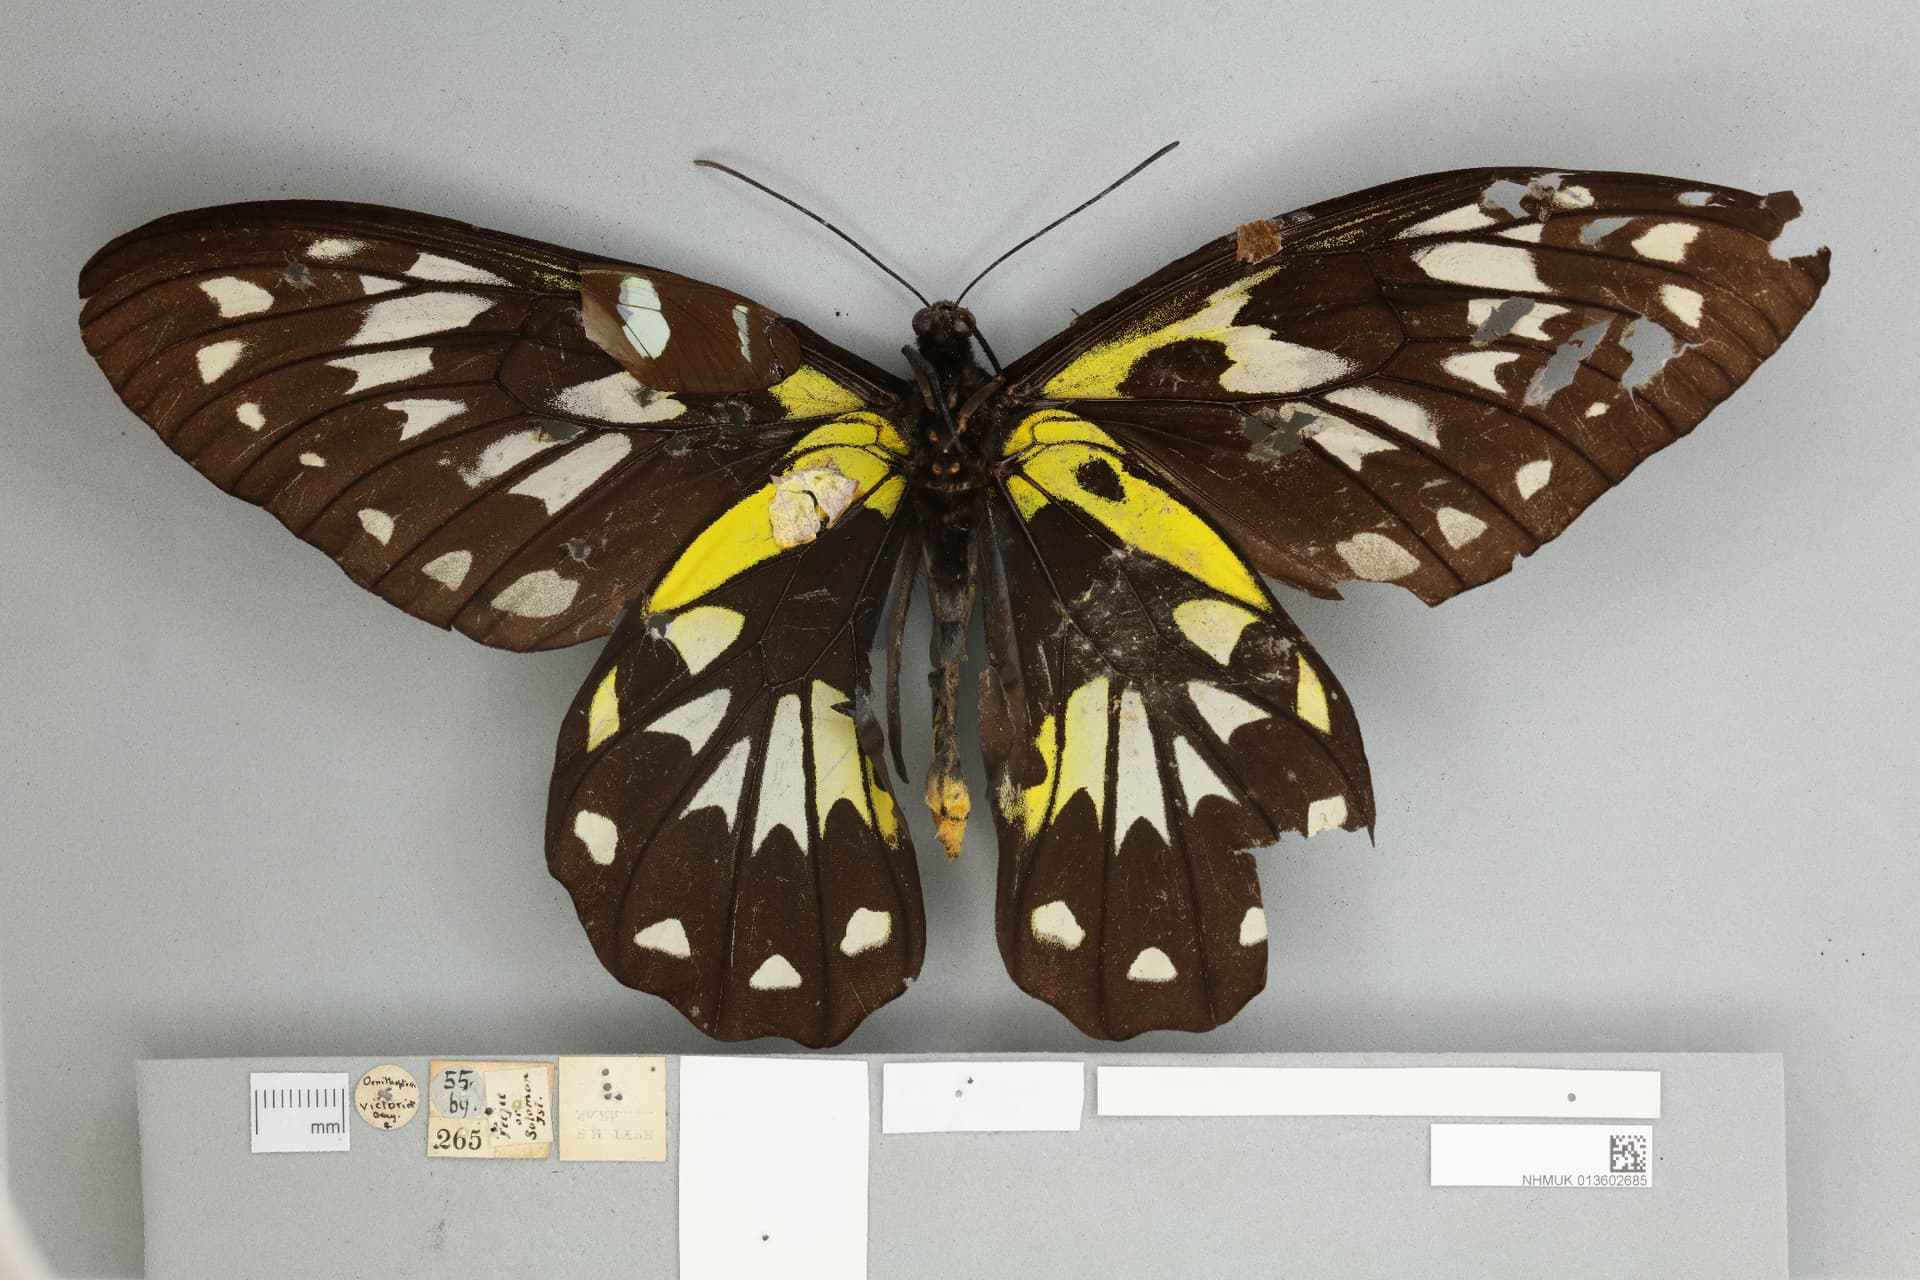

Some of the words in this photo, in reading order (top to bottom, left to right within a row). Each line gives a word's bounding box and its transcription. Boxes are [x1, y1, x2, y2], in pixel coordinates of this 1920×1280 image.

[311, 1122, 340, 1134] mm
[1522, 1174, 1573, 1186] NHMUK
[1577, 1174, 1648, 1187] 013602685
